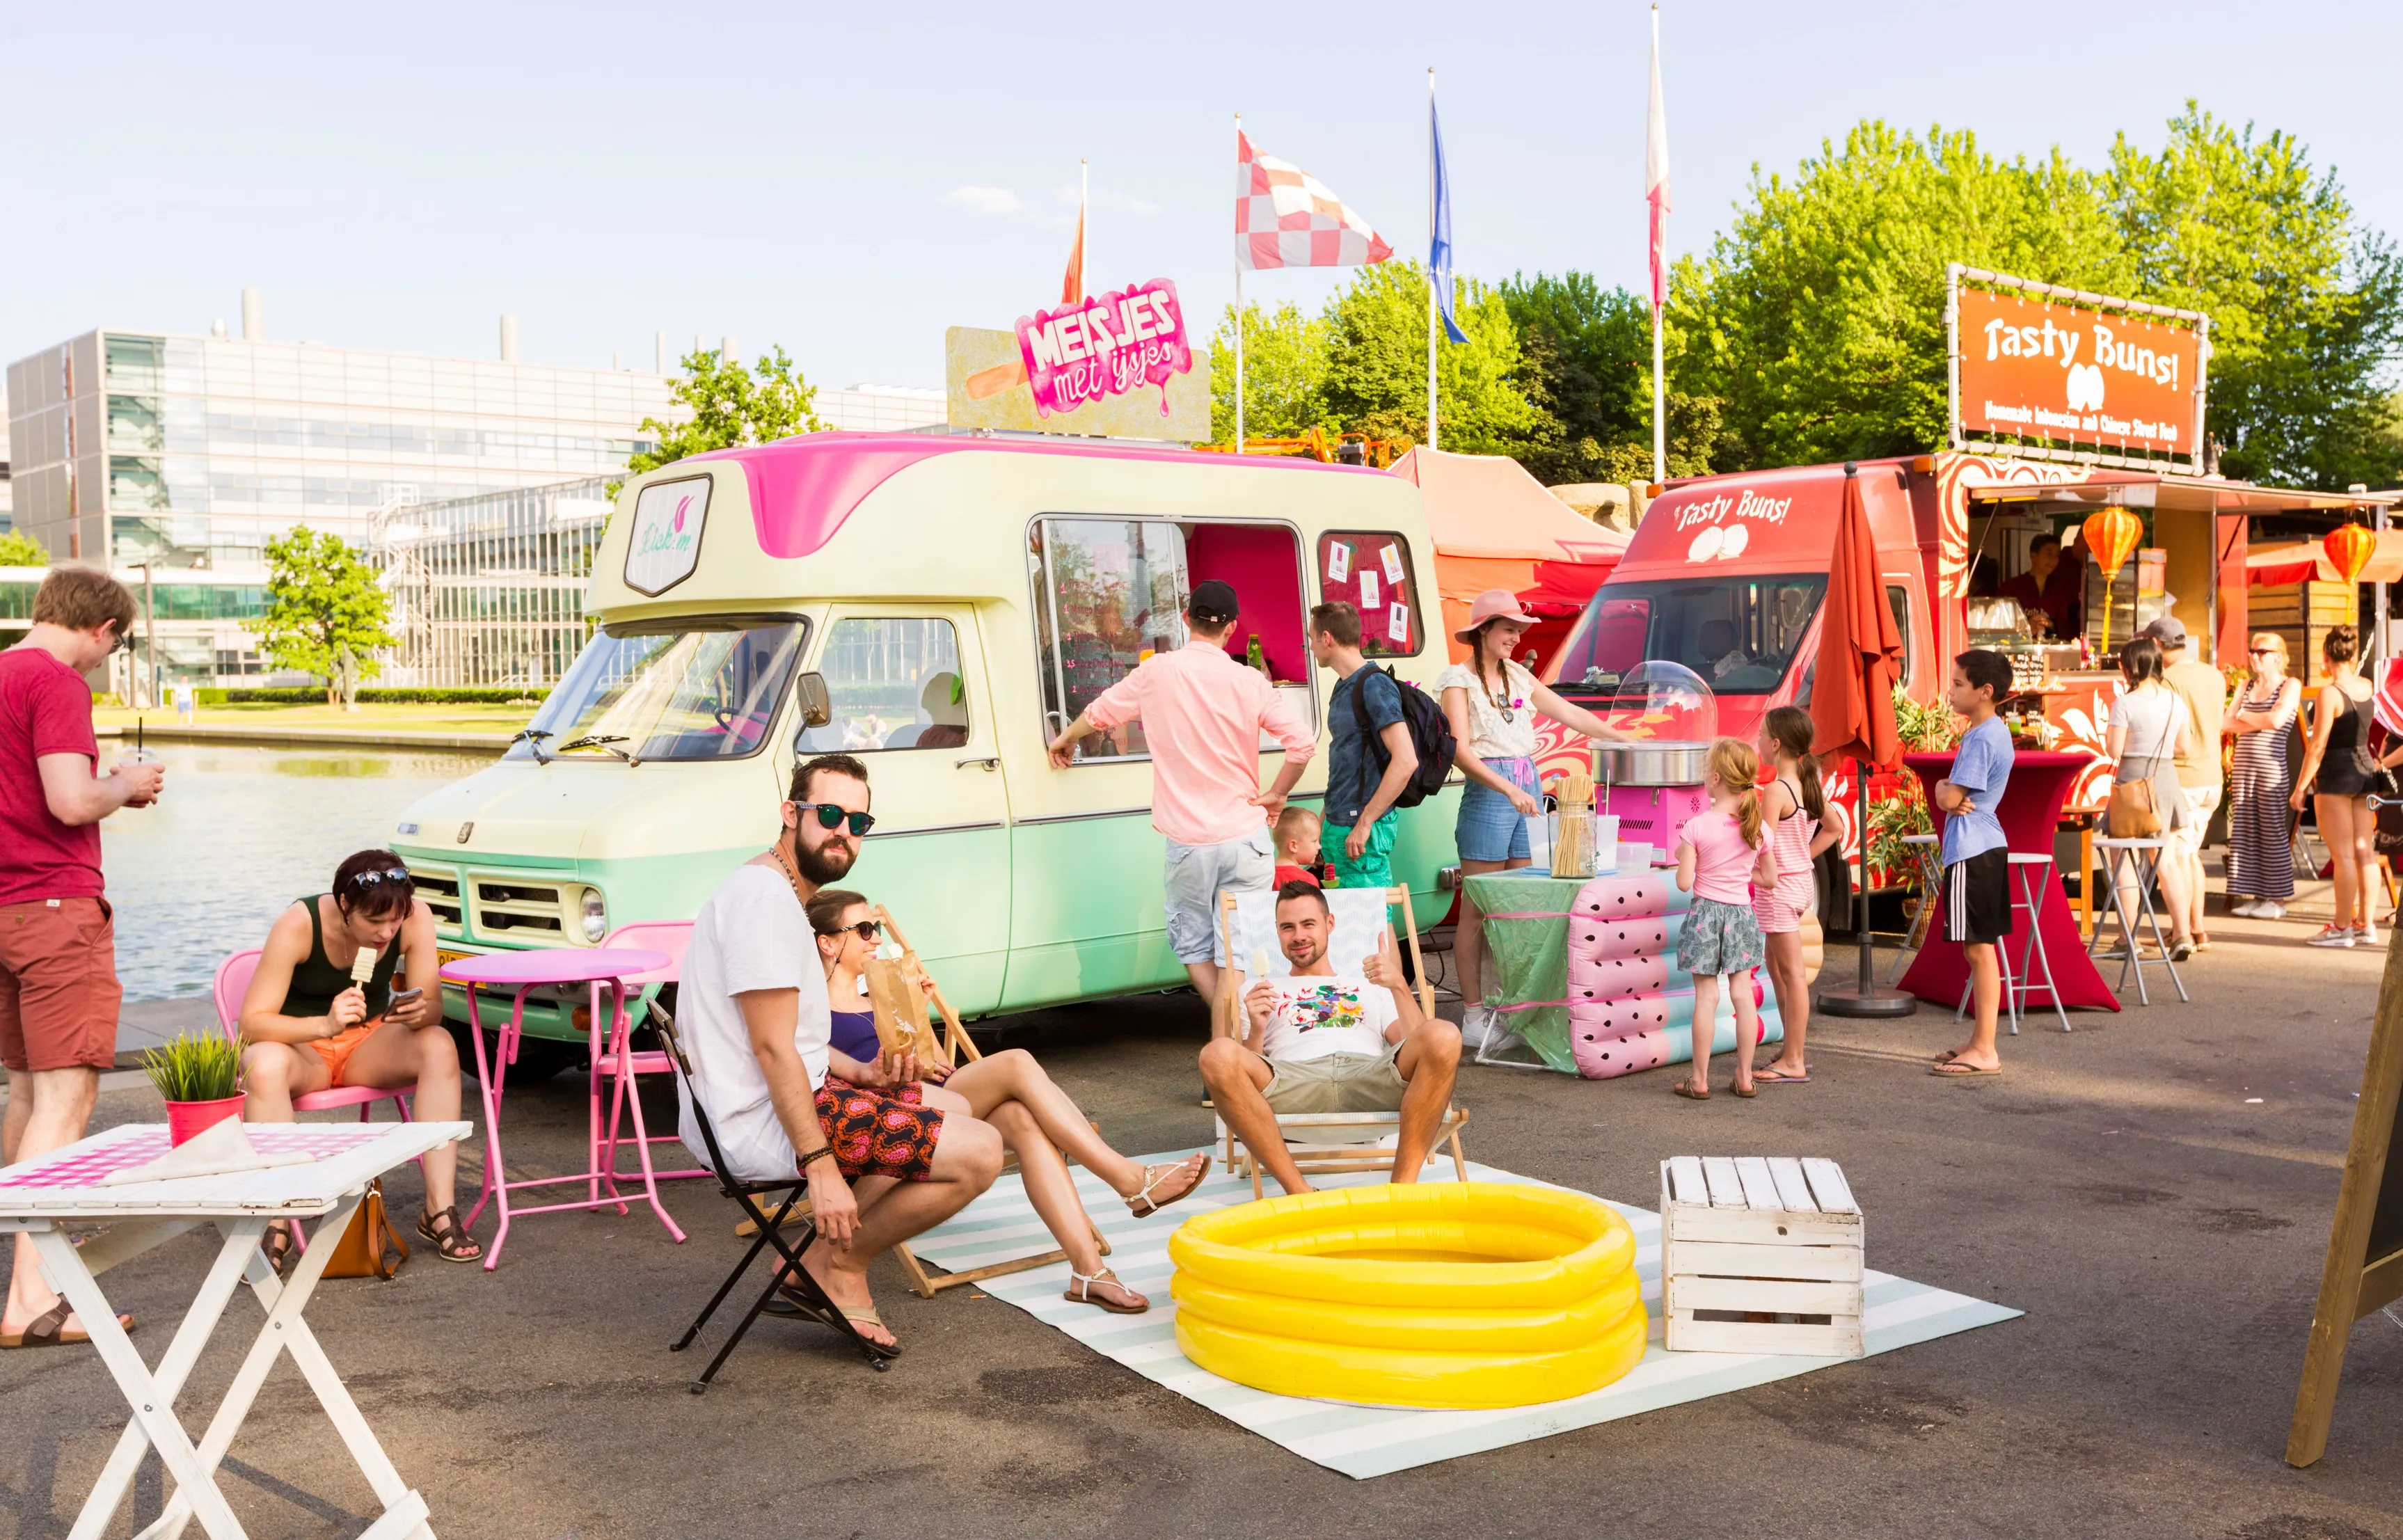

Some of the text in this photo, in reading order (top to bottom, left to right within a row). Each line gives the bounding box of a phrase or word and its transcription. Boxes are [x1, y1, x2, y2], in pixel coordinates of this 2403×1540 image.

[1027, 289, 1175, 372] MEISJES
[1985, 317, 2179, 391] Tasty Buns!
[1054, 341, 1173, 404] met ijsjes
[2082, 414, 2098, 431] and
[1676, 490, 1792, 532] Tasty Buns!
